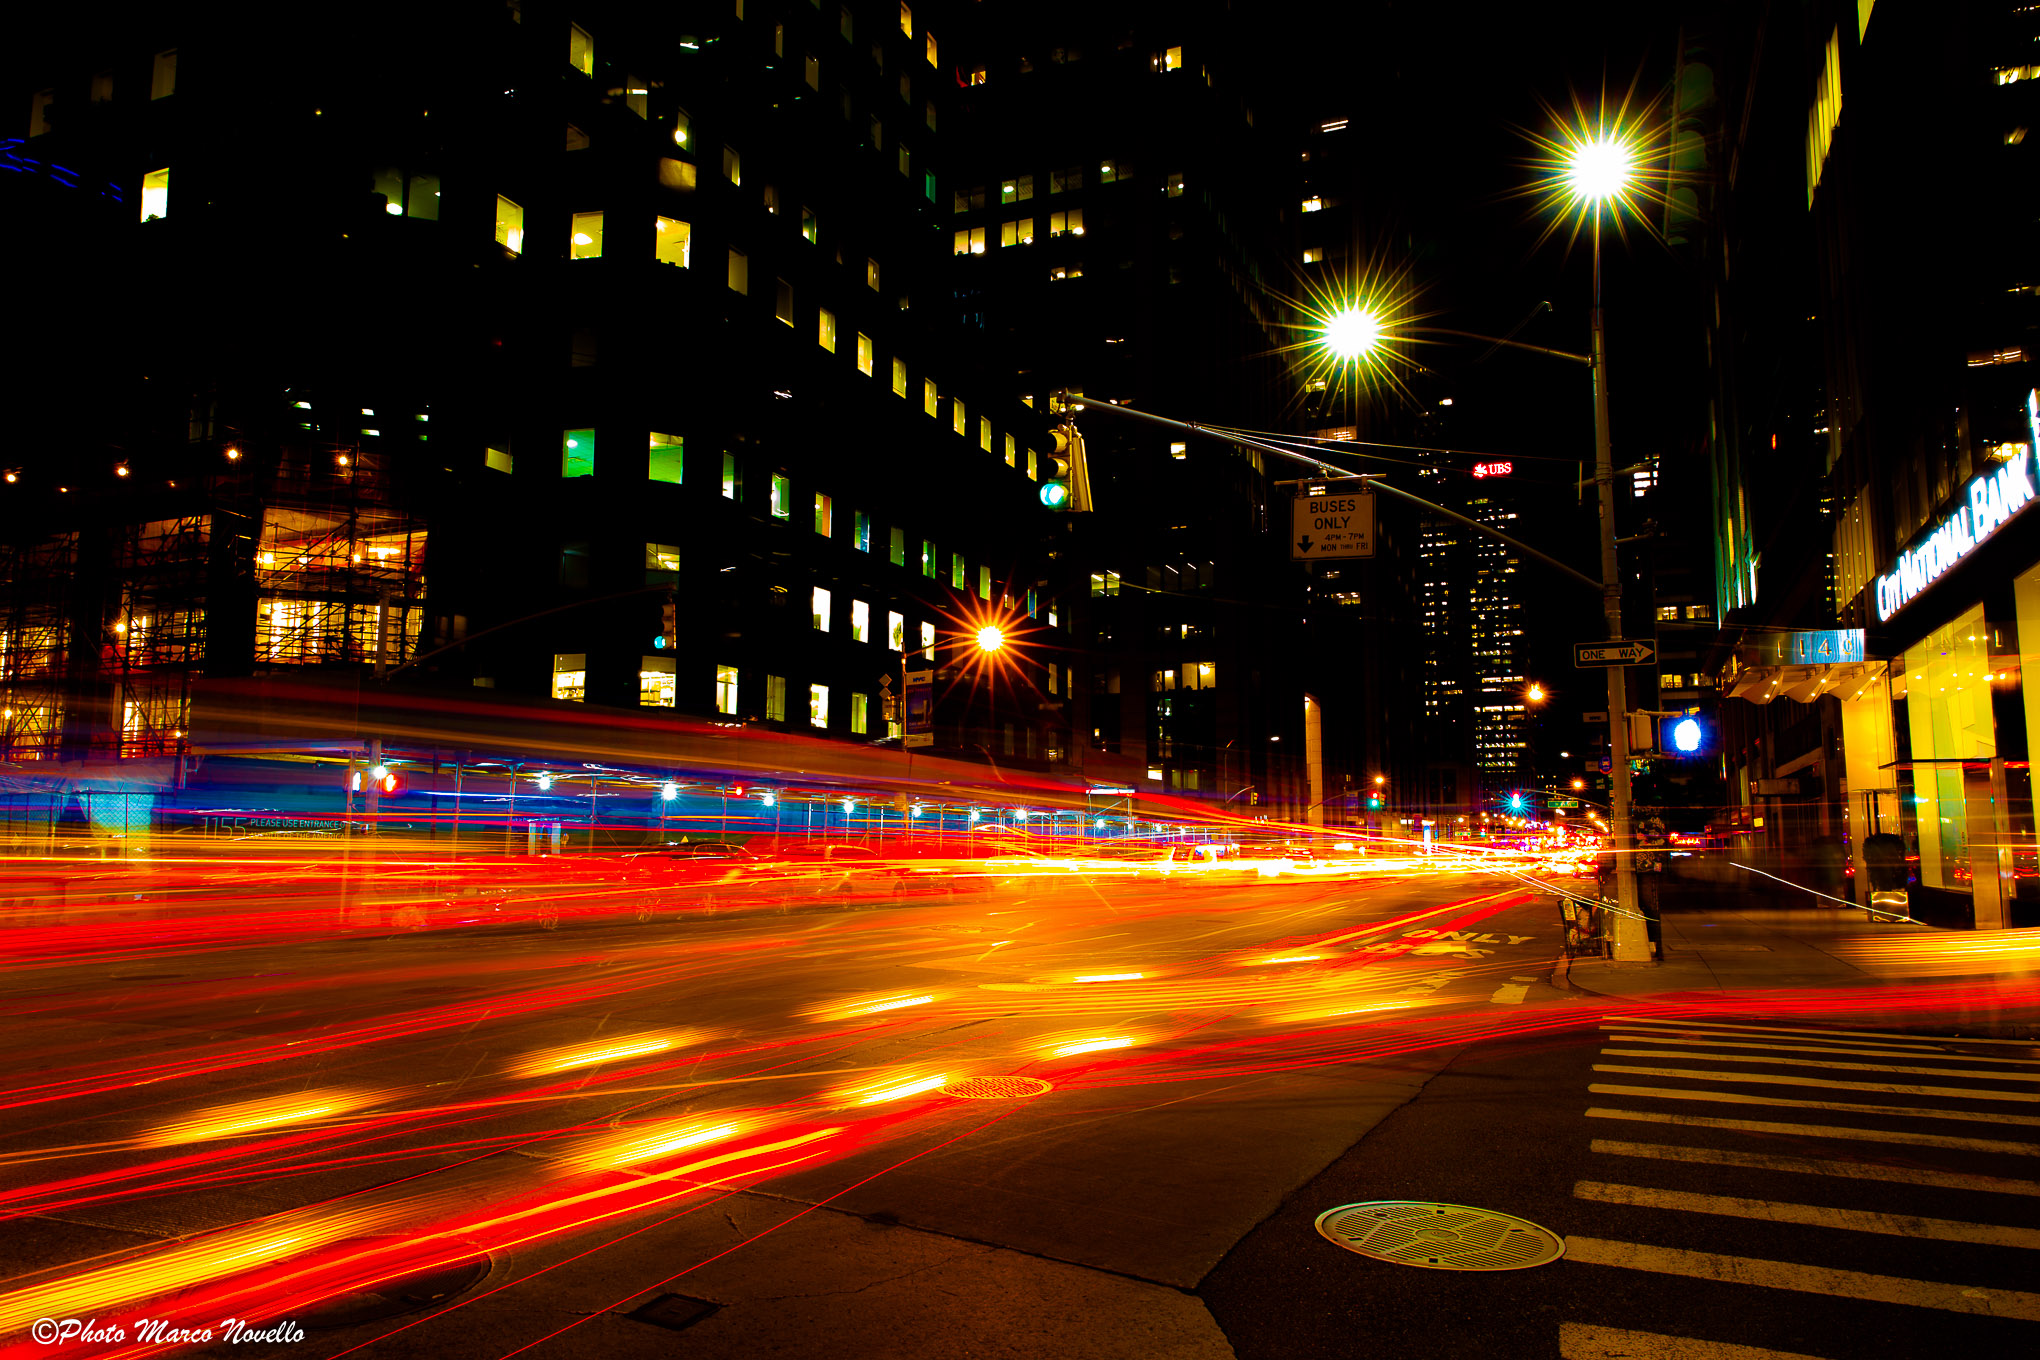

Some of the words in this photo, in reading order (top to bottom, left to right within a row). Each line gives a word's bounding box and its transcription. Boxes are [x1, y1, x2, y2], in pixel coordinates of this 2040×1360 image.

[1488, 462, 1512, 475] UBS
[1310, 499, 1356, 514] BUSES
[1314, 516, 1350, 530] ONLY
[1899, 505, 1974, 605] NATIONAL
[1971, 444, 2035, 544] BANK
[1321, 544, 1337, 552] MON
[1356, 542, 1368, 551] FRI
[1582, 649, 1606, 660] ONE
[1618, 647, 1644, 658] WAY
[201, 816, 248, 841] 1155
[250, 818, 281, 828] PLEASE
[282, 819, 300, 829] USE
[299, 819, 340, 829] ENTRANCE
[296, 832, 310, 841] THE
[312, 832, 345, 841] AMERICA
[1401, 928, 1537, 945] ONLY
